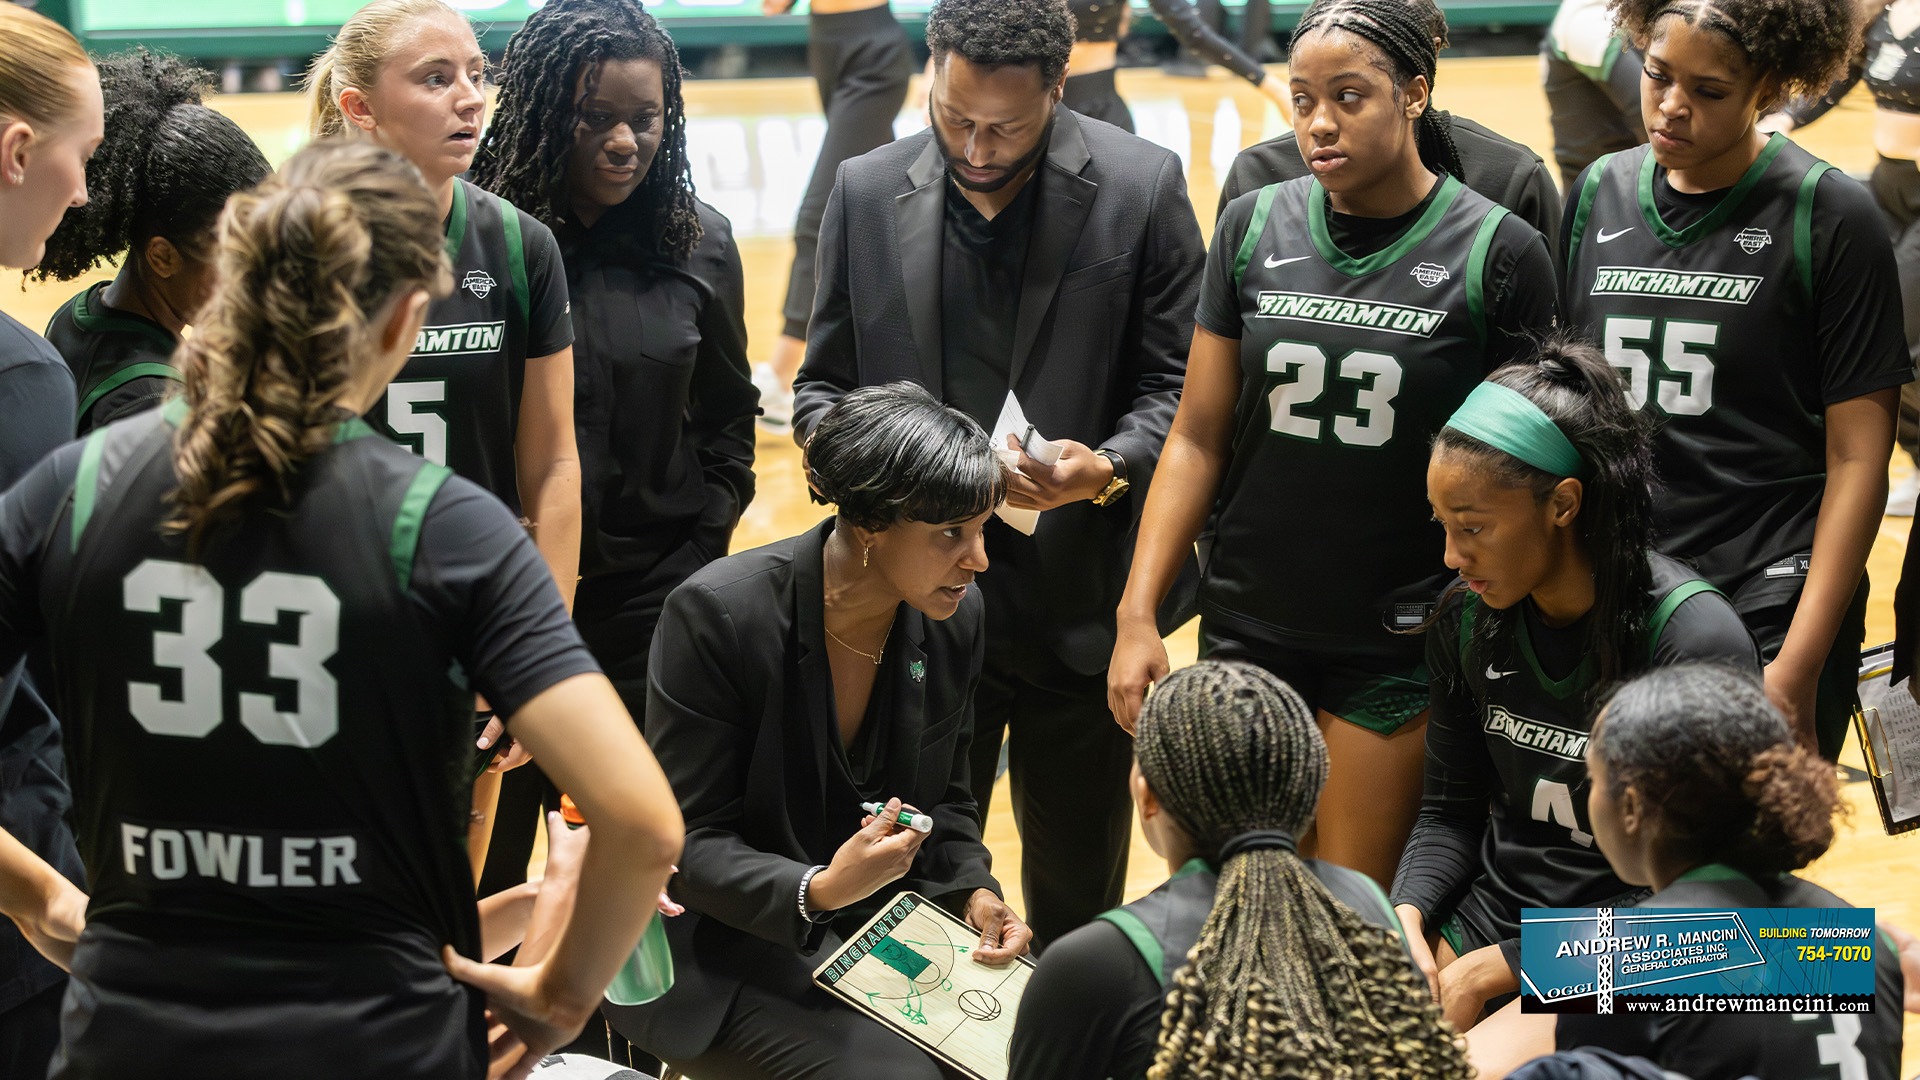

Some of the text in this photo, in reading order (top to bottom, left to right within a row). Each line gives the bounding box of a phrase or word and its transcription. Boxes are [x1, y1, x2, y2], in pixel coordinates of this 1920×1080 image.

[1735, 233, 1771, 244] AMERICA
[463, 278, 496, 288] AMERICA
[1411, 267, 1449, 279] AMERICA
[1595, 270, 1757, 300] BINGHAMTON
[1260, 294, 1440, 334] BINGHAMTON
[410, 325, 502, 352] AMTON
[1604, 317, 1718, 416] 55
[1266, 341, 1403, 447] 23
[387, 380, 447, 468] 5
[123, 559, 341, 748] 33
[1489, 709, 1590, 758] BINGHAM
[121, 822, 362, 887] FOWLER
[799, 880, 808, 904] LIVES
[824, 896, 916, 982] BINGHAMTON
